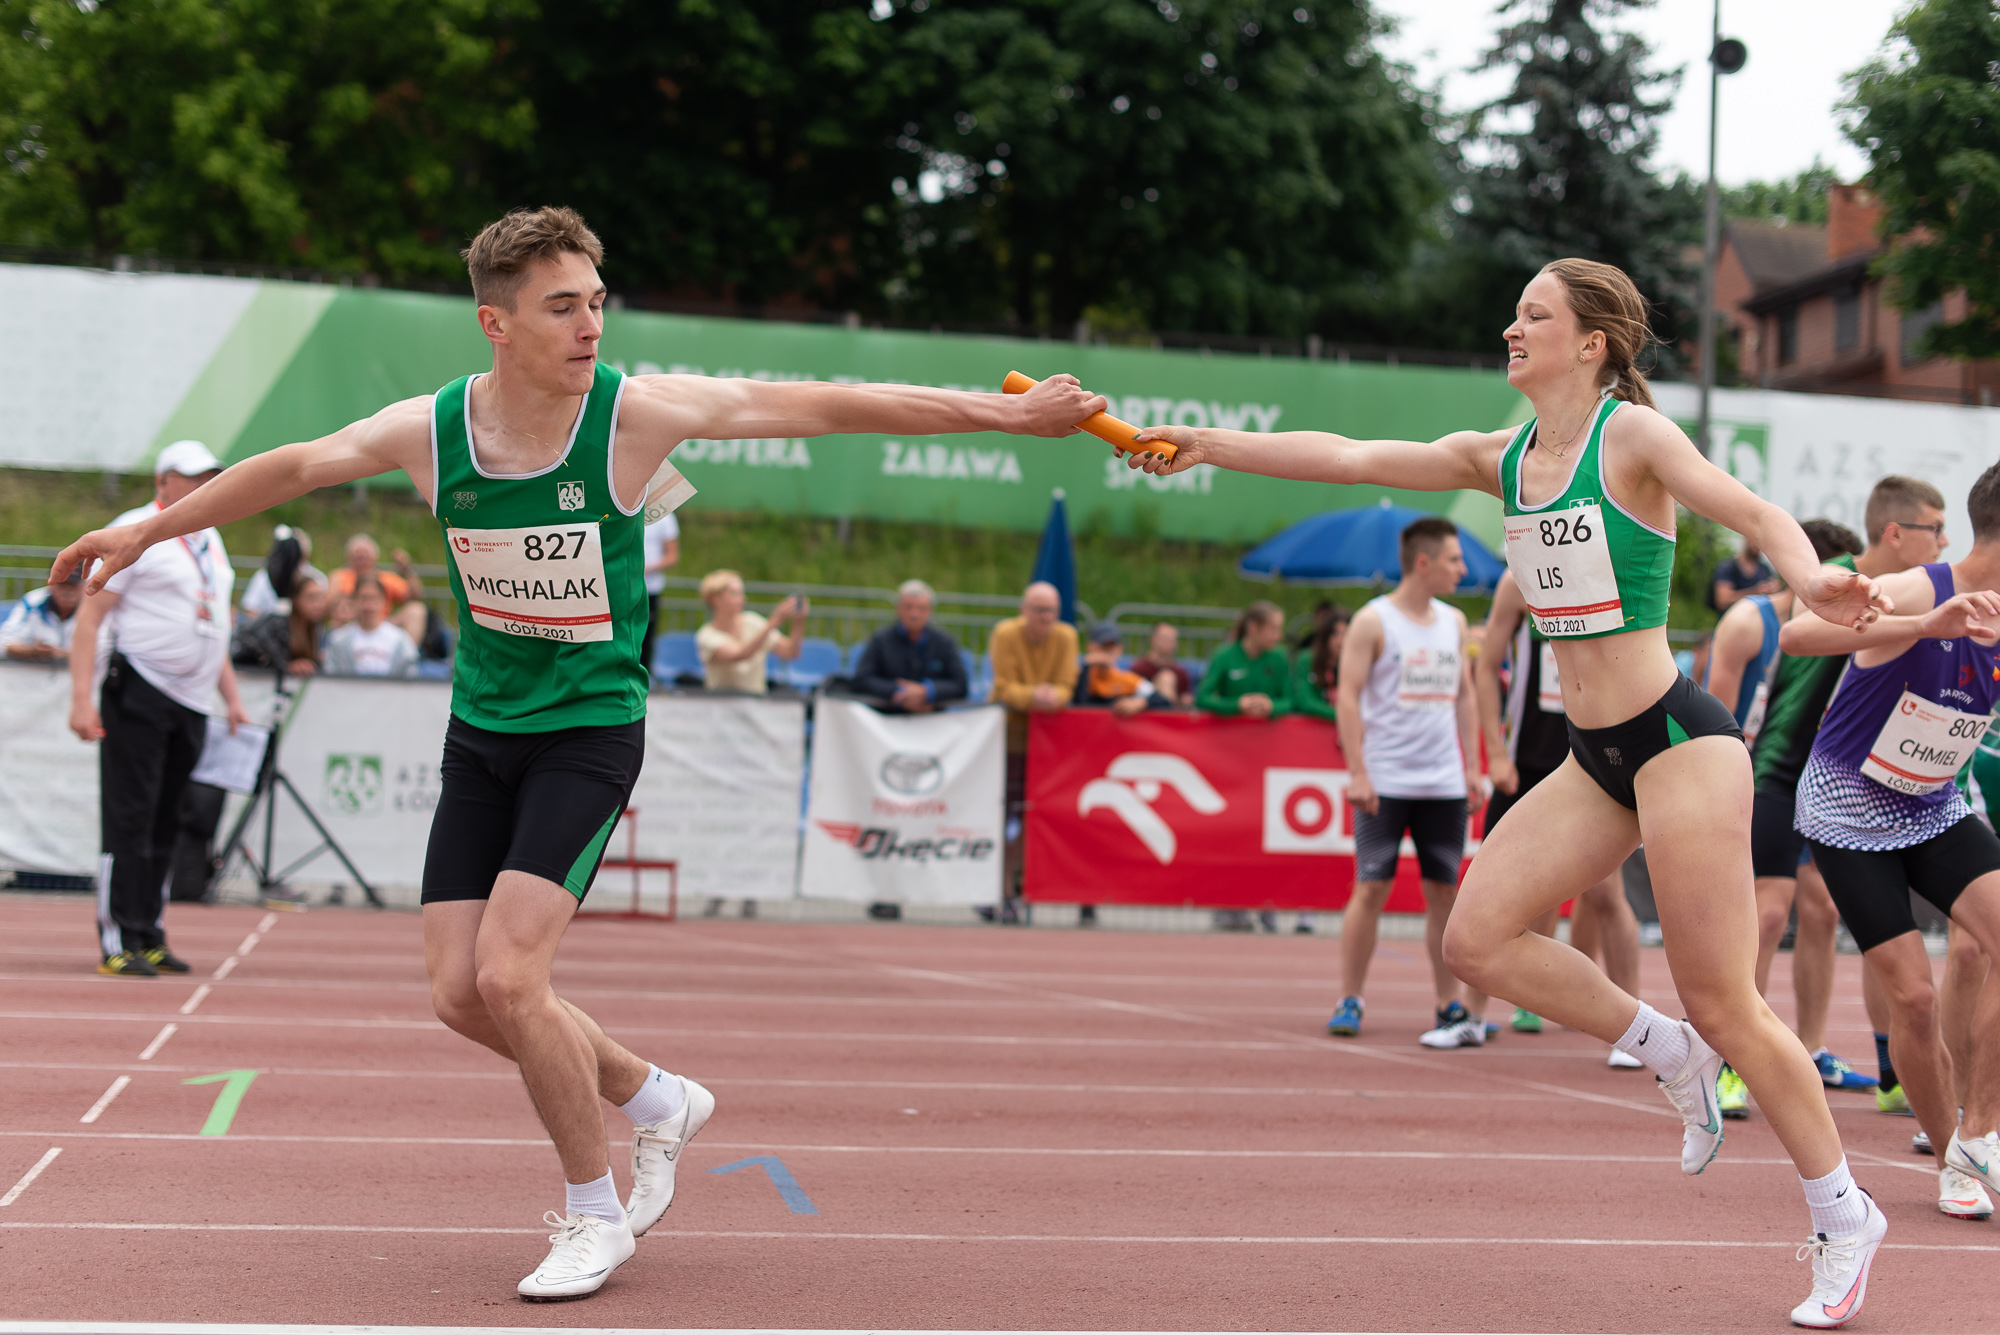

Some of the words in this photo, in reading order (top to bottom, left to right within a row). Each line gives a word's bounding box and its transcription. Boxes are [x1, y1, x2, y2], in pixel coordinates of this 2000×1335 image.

[881, 440, 1023, 484] ZABAWA
[1539, 514, 1592, 547] 826
[523, 530, 587, 561] 827
[466, 573, 600, 600] MICHALAK
[1536, 566, 1564, 590] LIS
[503, 621, 540, 636] ŁÓDŹ
[542, 627, 574, 641] 2021
[1563, 619, 1586, 632] 2021
[1948, 718, 1987, 739] 800
[1899, 739, 1959, 767] CHMIEL
